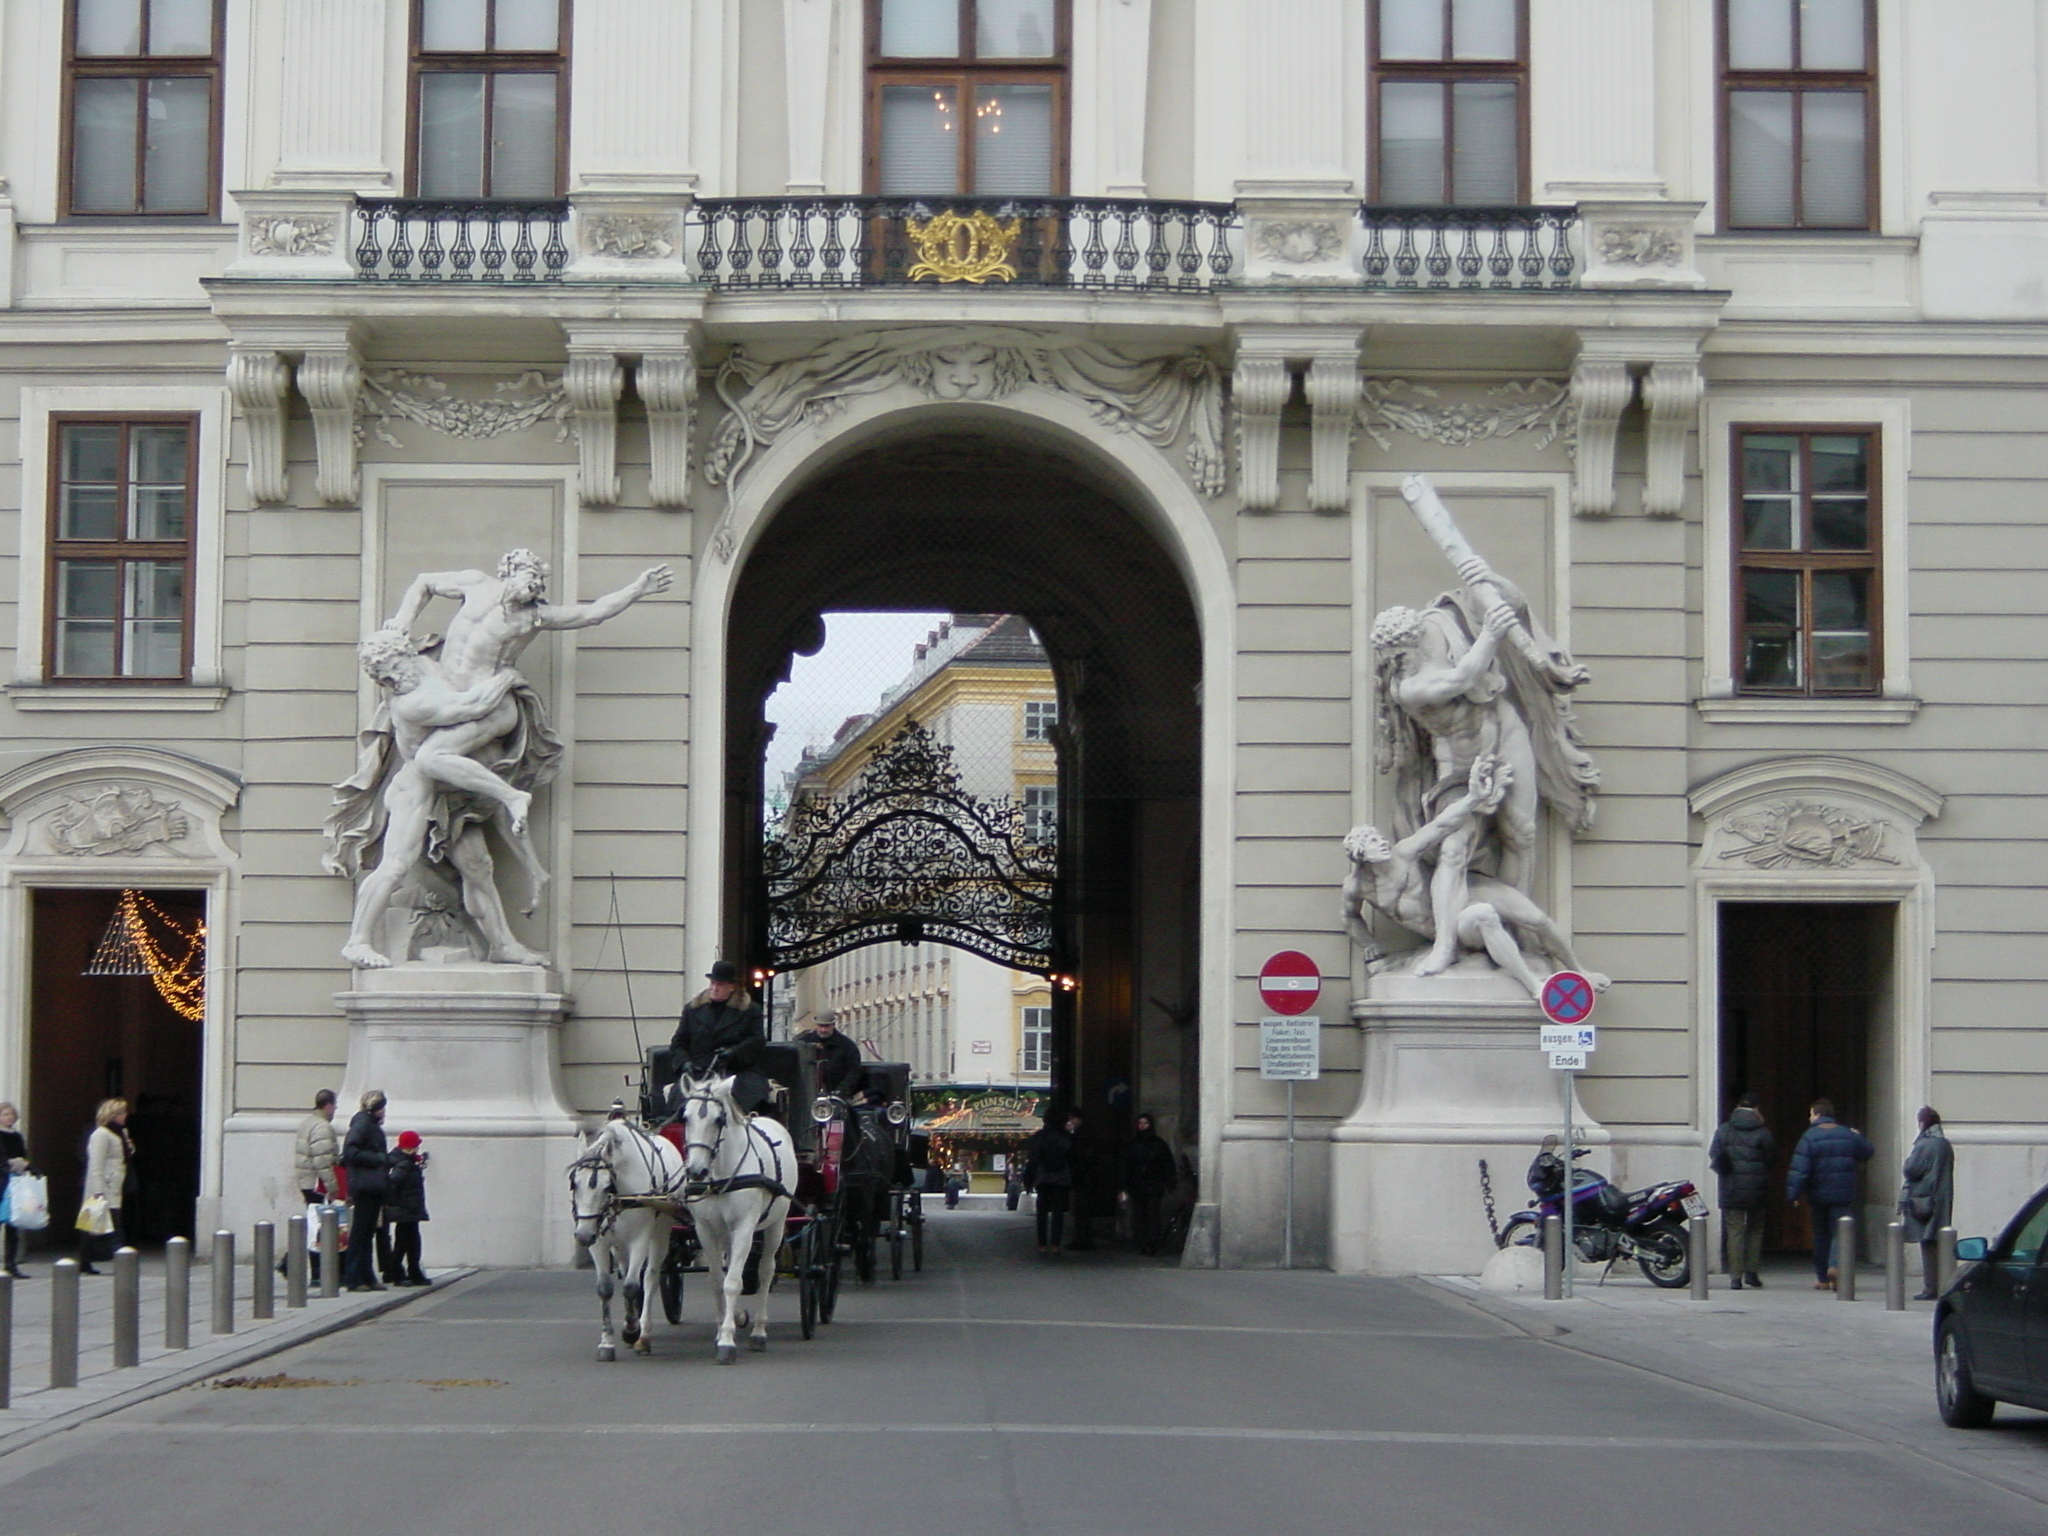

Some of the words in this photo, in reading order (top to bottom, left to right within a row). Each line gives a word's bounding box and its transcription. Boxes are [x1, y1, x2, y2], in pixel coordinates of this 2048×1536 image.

[1542, 1035, 1576, 1045] ausgen.
[1555, 1055, 1579, 1066] Ende
[973, 1097, 1022, 1111] PUNSCH
